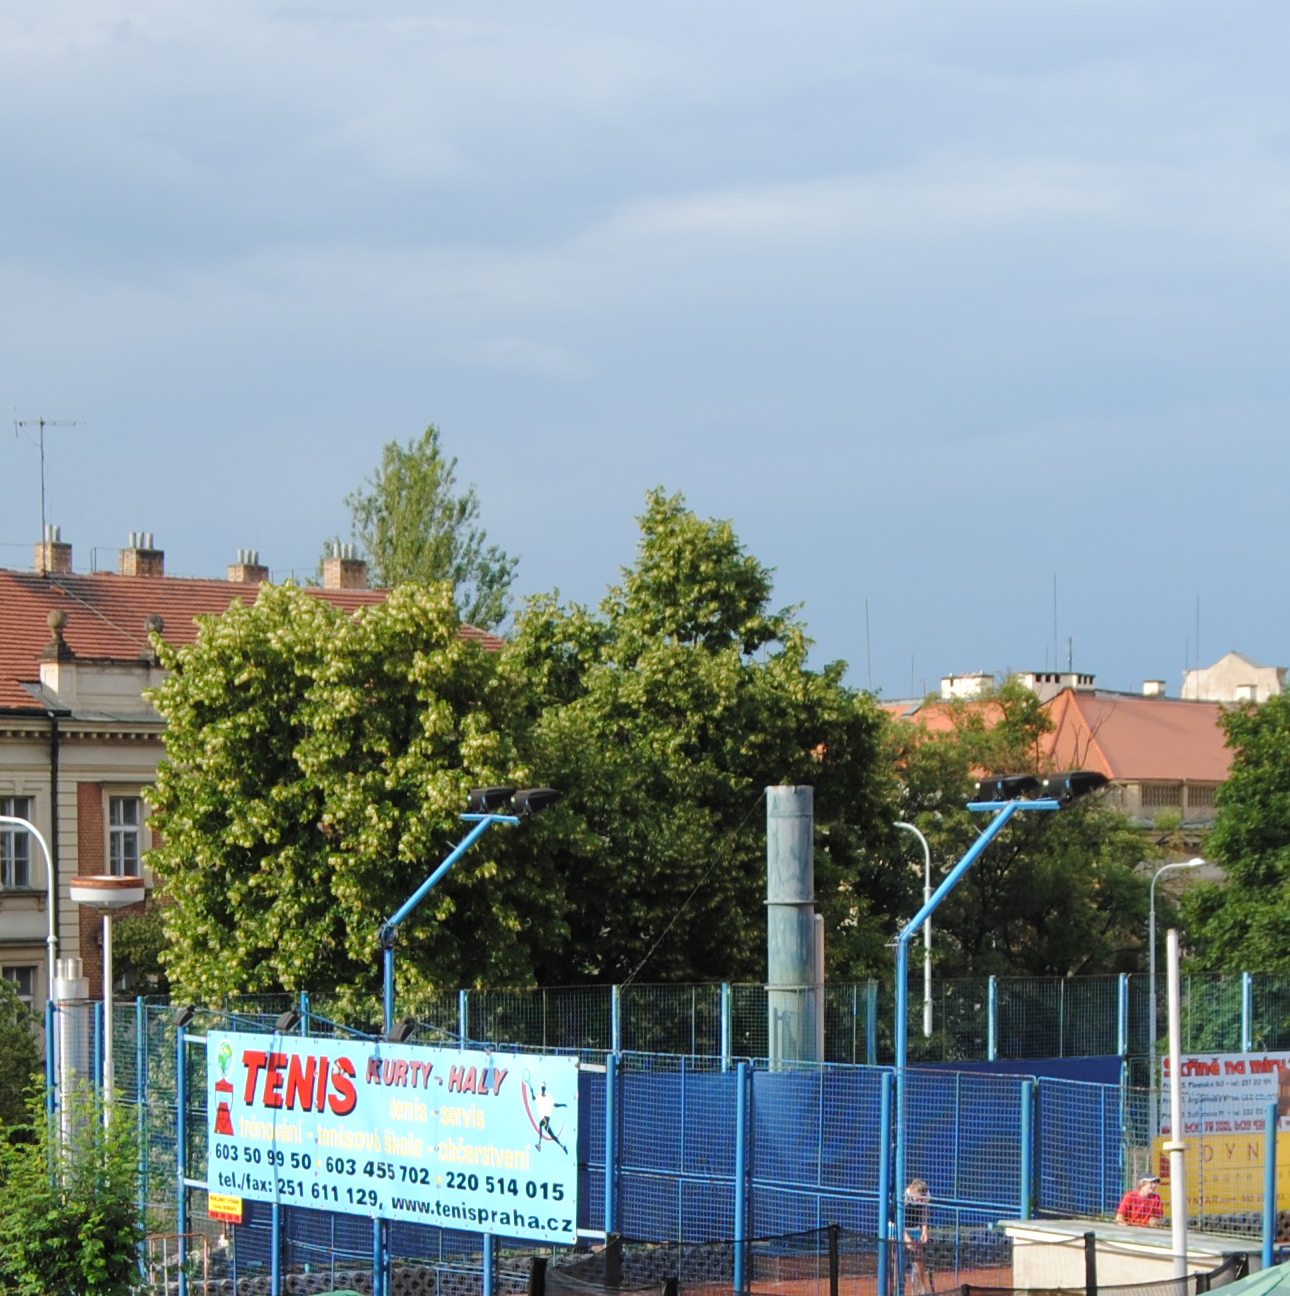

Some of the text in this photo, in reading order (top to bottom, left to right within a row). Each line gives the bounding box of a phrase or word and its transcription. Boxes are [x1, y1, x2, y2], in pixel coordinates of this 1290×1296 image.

[242, 1049, 358, 1117] TENIS
[365, 1055, 434, 1089] KURTY
[448, 1064, 508, 1096] HALY
[1225, 1061, 1245, 1075] na
[389, 1096, 427, 1122] tenis
[440, 1103, 485, 1129] servis
[215, 1143, 564, 1201] 603 50 99 50 603 455 702 220 514 015
[218, 1171, 573, 1233] tel./fax: 251 611 129, www.tenispraha.cz
